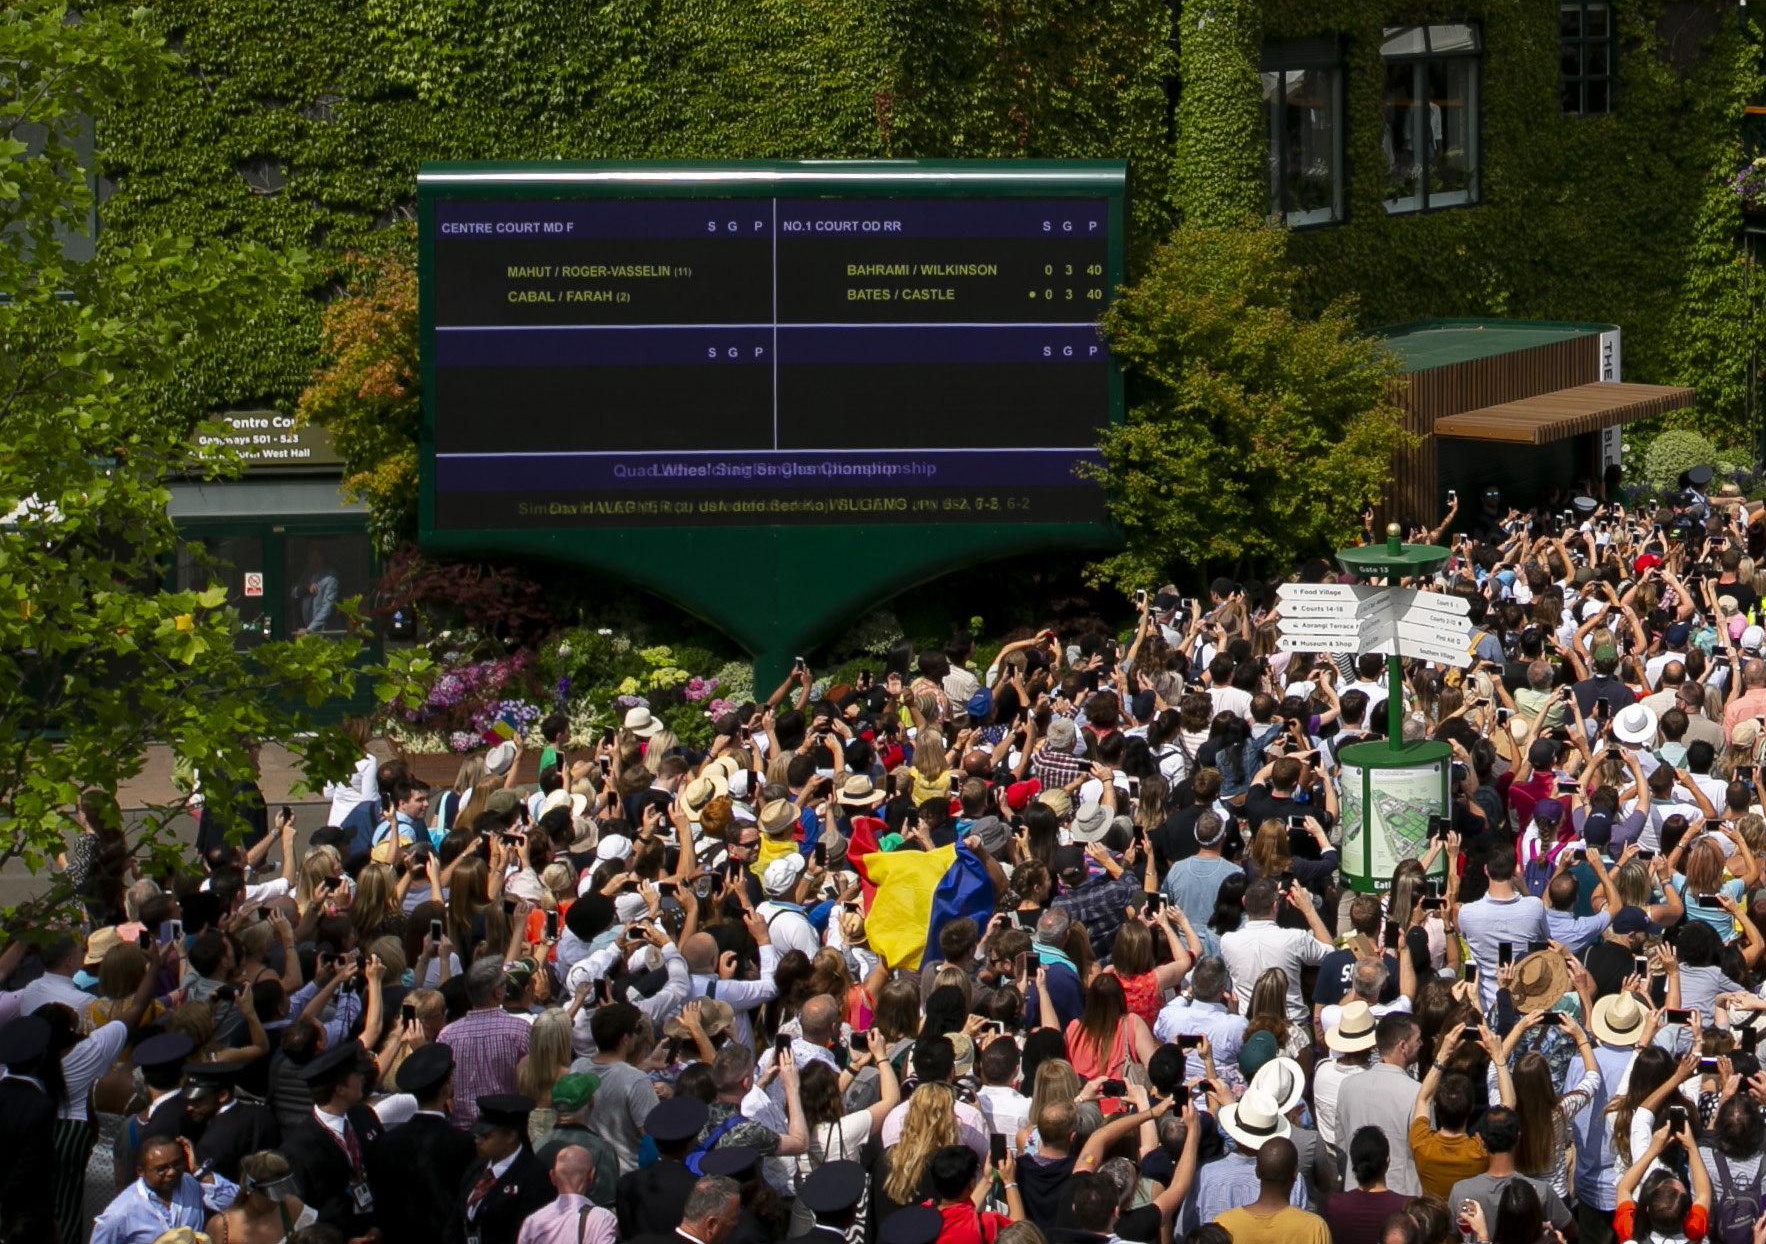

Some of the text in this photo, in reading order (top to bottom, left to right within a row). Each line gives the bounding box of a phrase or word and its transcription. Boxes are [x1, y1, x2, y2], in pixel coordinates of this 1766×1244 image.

[441, 222, 575, 233] CENTRE COURT MD F
[707, 221, 763, 232] S G P
[783, 221, 902, 231] NO.1 COURT OD RR
[1042, 221, 1097, 231] S G P
[507, 266, 552, 278] MAHUT
[562, 266, 671, 277] ROGER-VASSELIN
[674, 267, 692, 278] (11)
[847, 264, 910, 276] BAHRAMI
[920, 264, 997, 276] WILKINSON
[1044, 265, 1103, 276] 0 3 40
[508, 291, 555, 303] CABAL
[566, 290, 613, 302] FARAH
[616, 292, 631, 303] (2)
[847, 289, 891, 301] BATES
[902, 289, 955, 301] CASTLE
[1044, 289, 1103, 301] 0 3 40
[708, 347, 764, 358] S G P
[1043, 346, 1098, 357] S G P
[1604, 341, 1613, 381] THE
[272, 416, 311, 428] Cou
[252, 435, 271, 445] 501
[235, 449, 261, 459] orth
[262, 448, 288, 459] West
[290, 448, 311, 458] Hall
[1420, 648, 1456, 660] Southern Village
[1374, 881, 1391, 889] Eat
